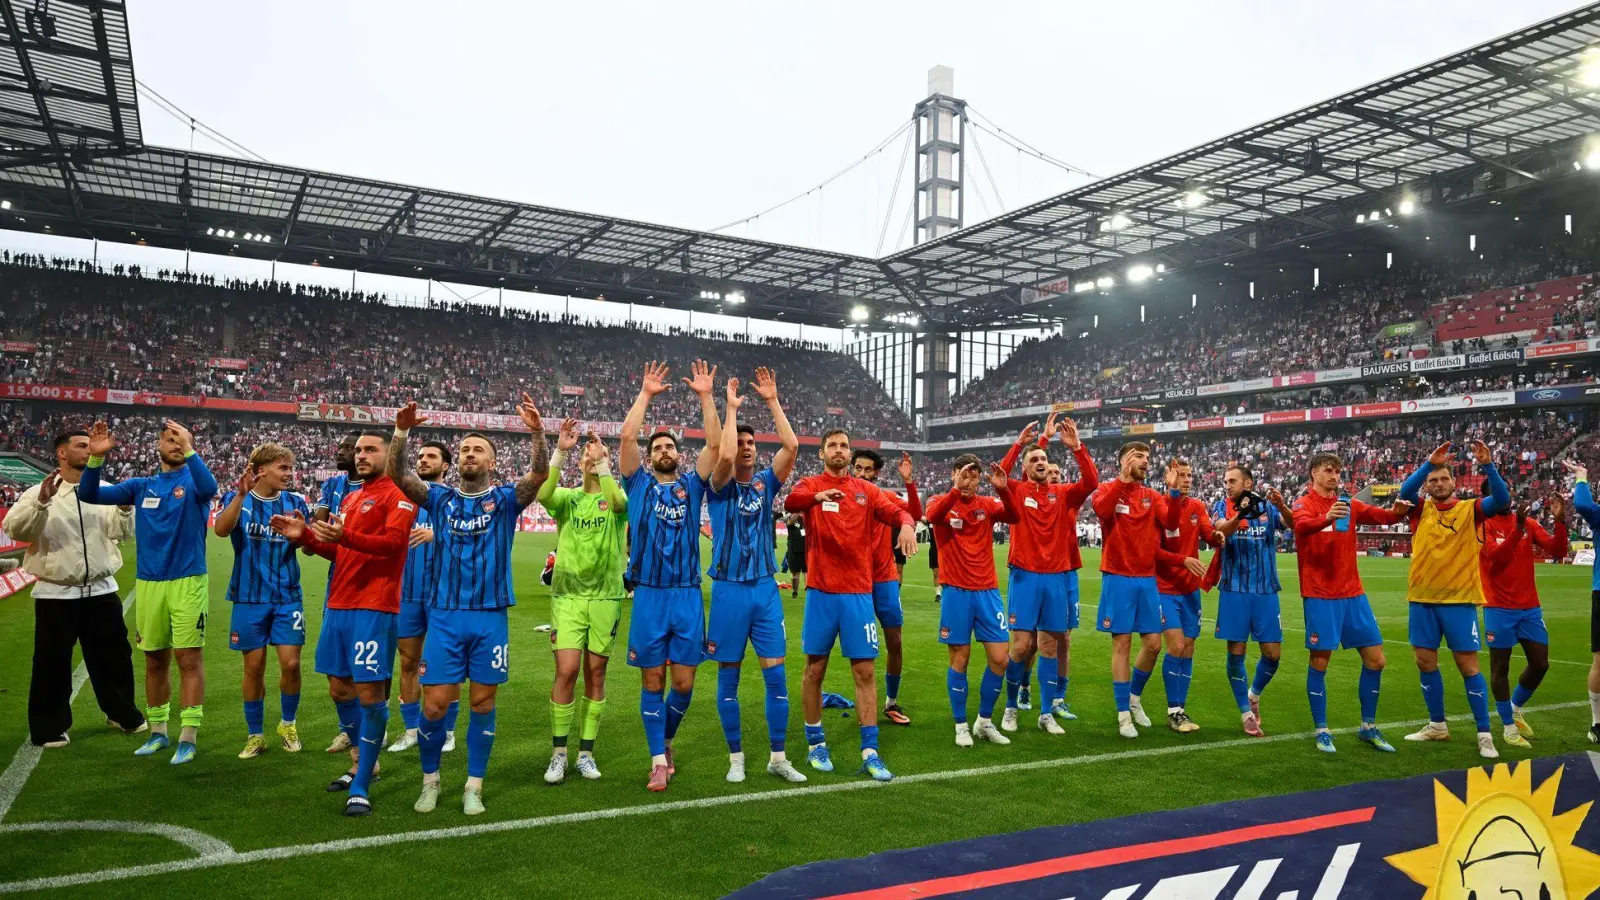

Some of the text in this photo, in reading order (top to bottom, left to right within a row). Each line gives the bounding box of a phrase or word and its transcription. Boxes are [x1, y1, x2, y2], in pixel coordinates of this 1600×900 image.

[1363, 362, 1409, 376] BAUWENS
[7, 384, 95, 400] 15.000 x FC
[1165, 388, 1195, 399] KEUK.EU
[1190, 420, 1221, 428] HAGEDORN
[415, 522, 433, 530] MH
[864, 622, 878, 643] 18
[354, 640, 378, 665] 22
